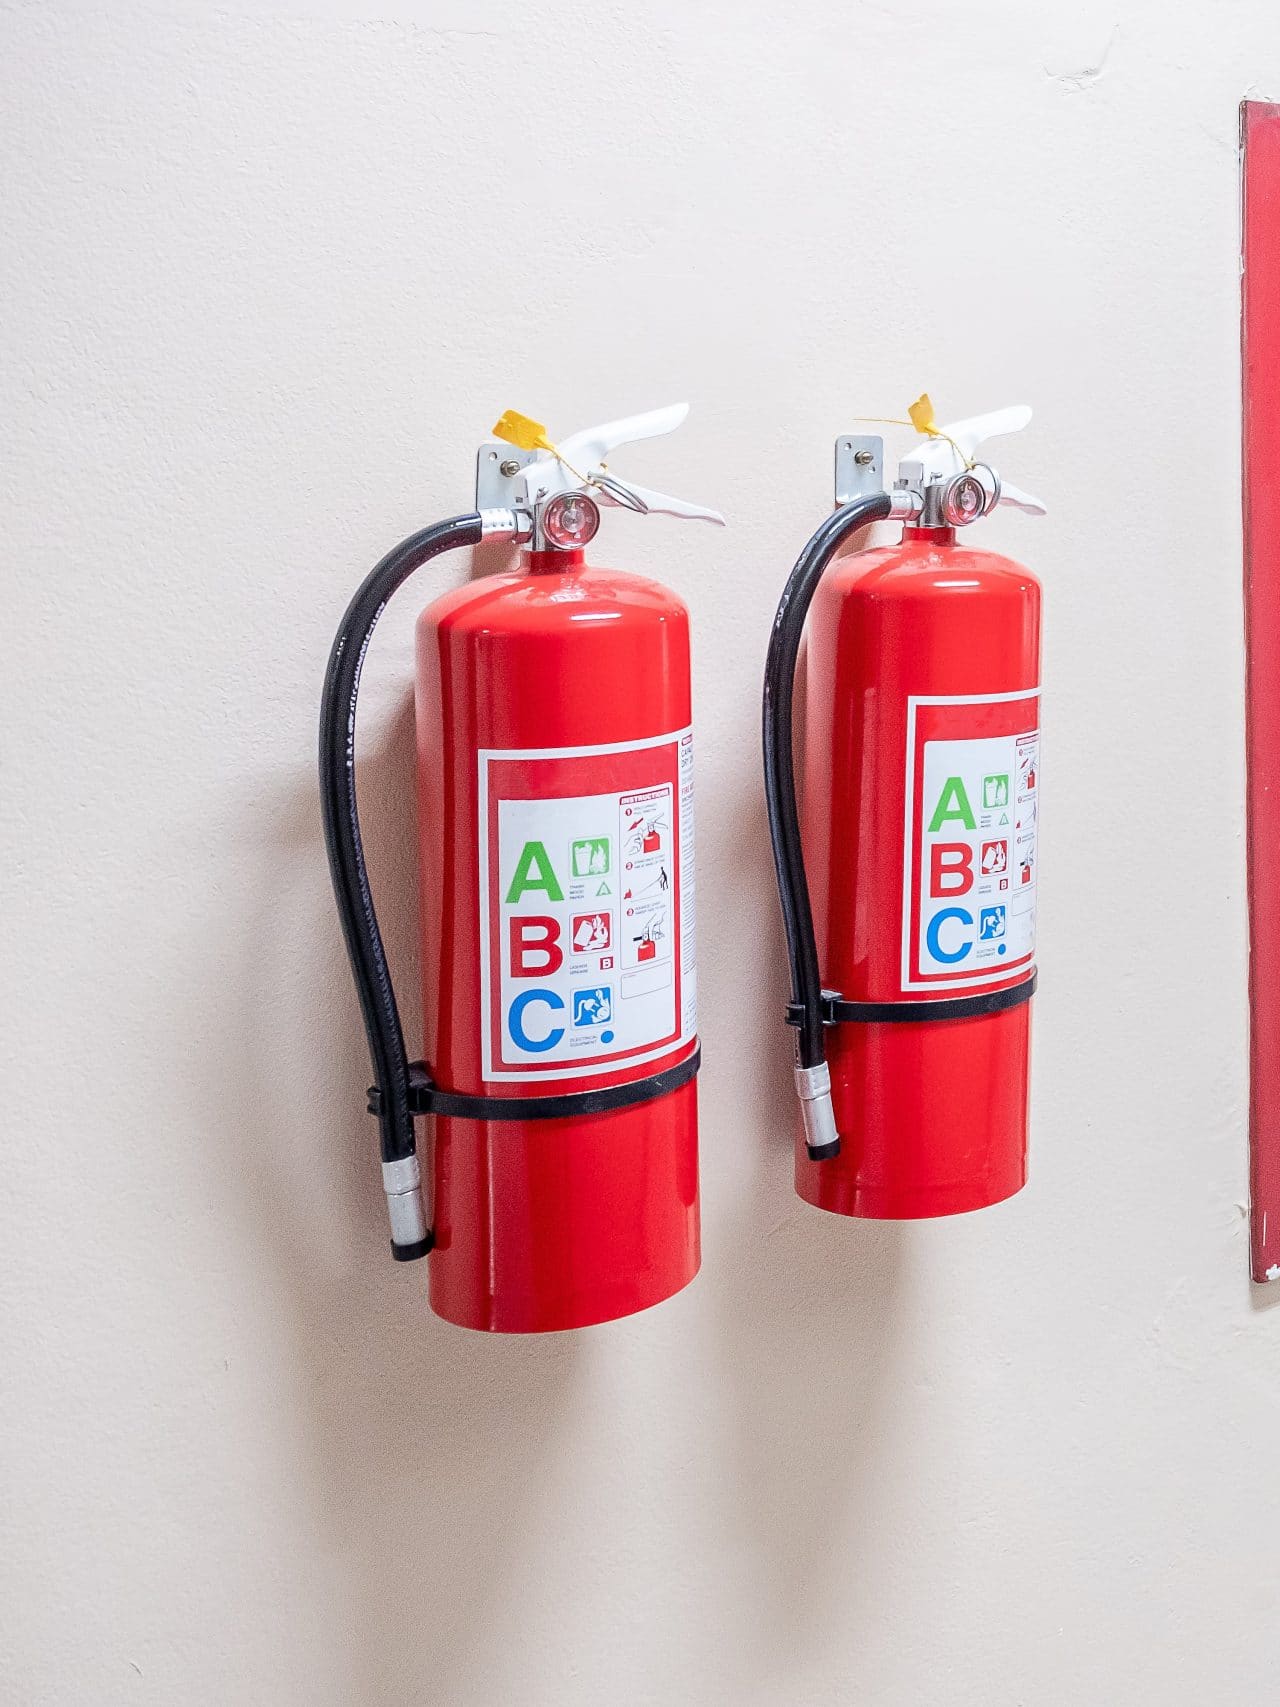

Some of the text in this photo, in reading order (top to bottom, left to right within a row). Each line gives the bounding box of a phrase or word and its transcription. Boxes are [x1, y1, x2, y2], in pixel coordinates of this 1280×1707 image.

[928, 776, 977, 833] A
[505, 840, 565, 904] A
[930, 842, 974, 898] B
[510, 915, 564, 978] B
[601, 957, 612, 969] B
[926, 907, 974, 964] C
[508, 988, 565, 1053] C
